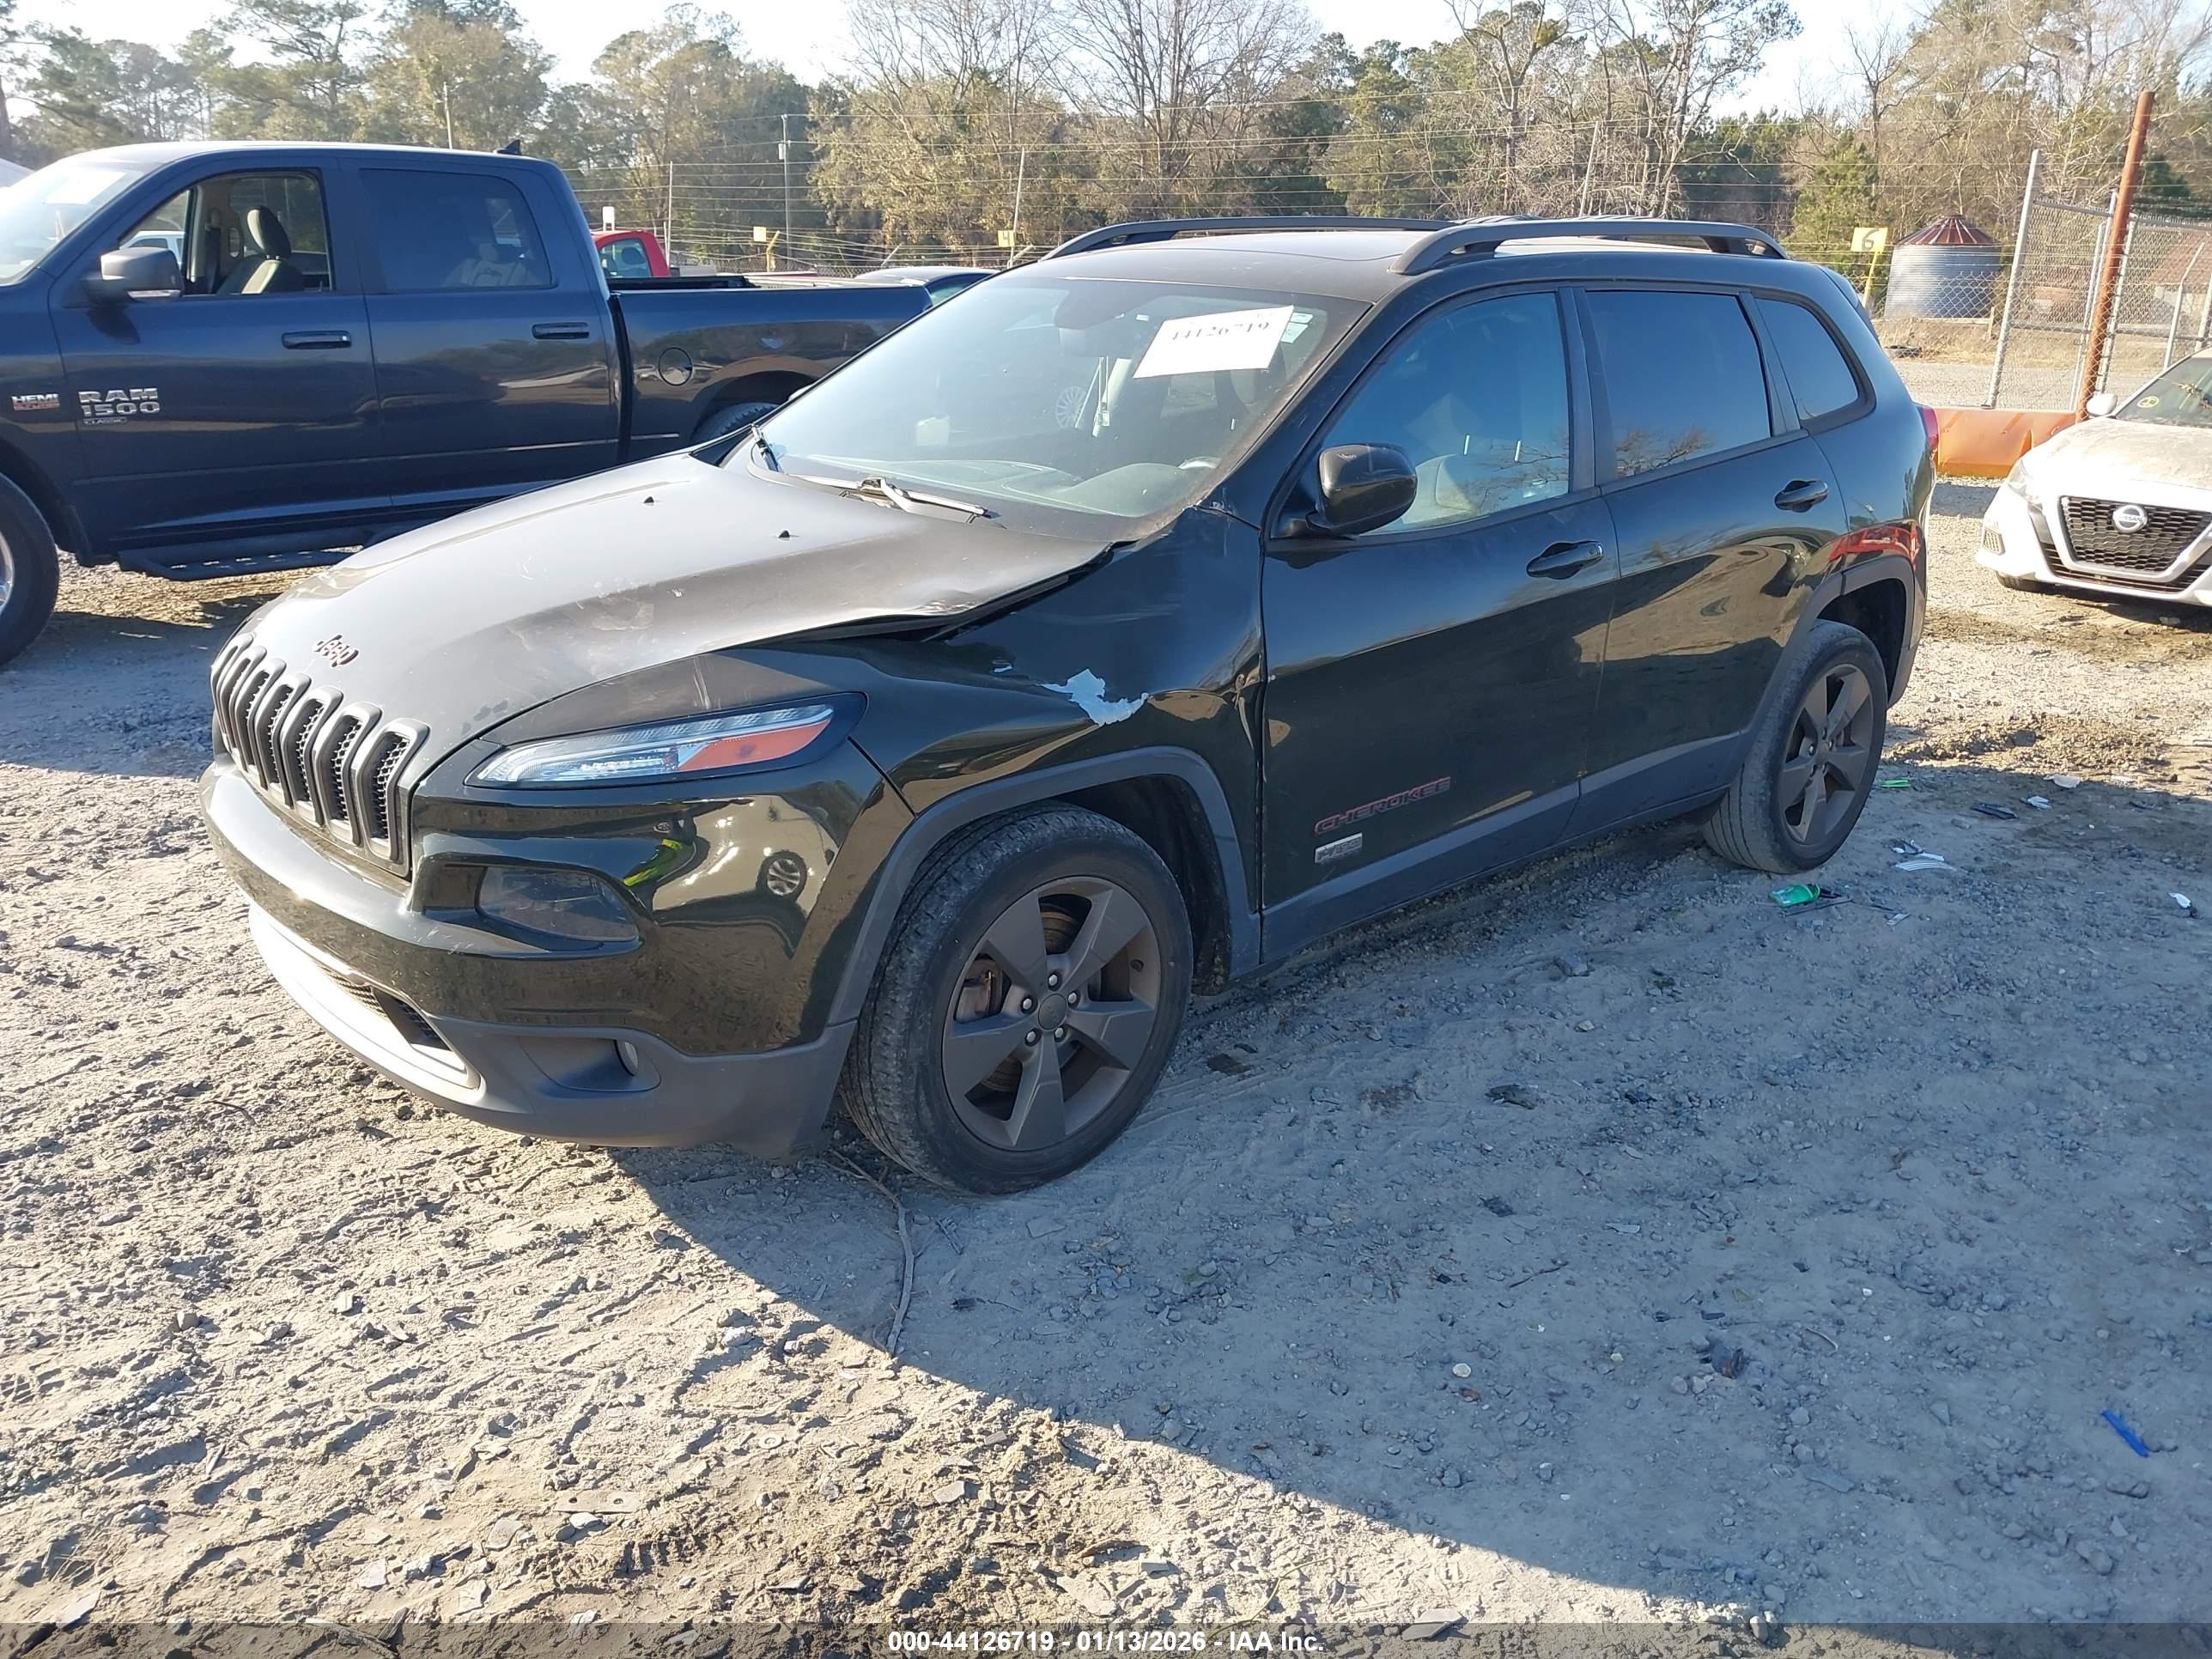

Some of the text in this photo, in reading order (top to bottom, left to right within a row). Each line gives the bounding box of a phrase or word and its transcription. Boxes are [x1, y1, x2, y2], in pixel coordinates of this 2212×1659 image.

[1862, 228, 1880, 251] 6
[11, 393, 59, 404] HEMI
[78, 387, 158, 403] RAM
[81, 401, 161, 417] 1500
[1314, 776, 1450, 836] CHEROKEE
